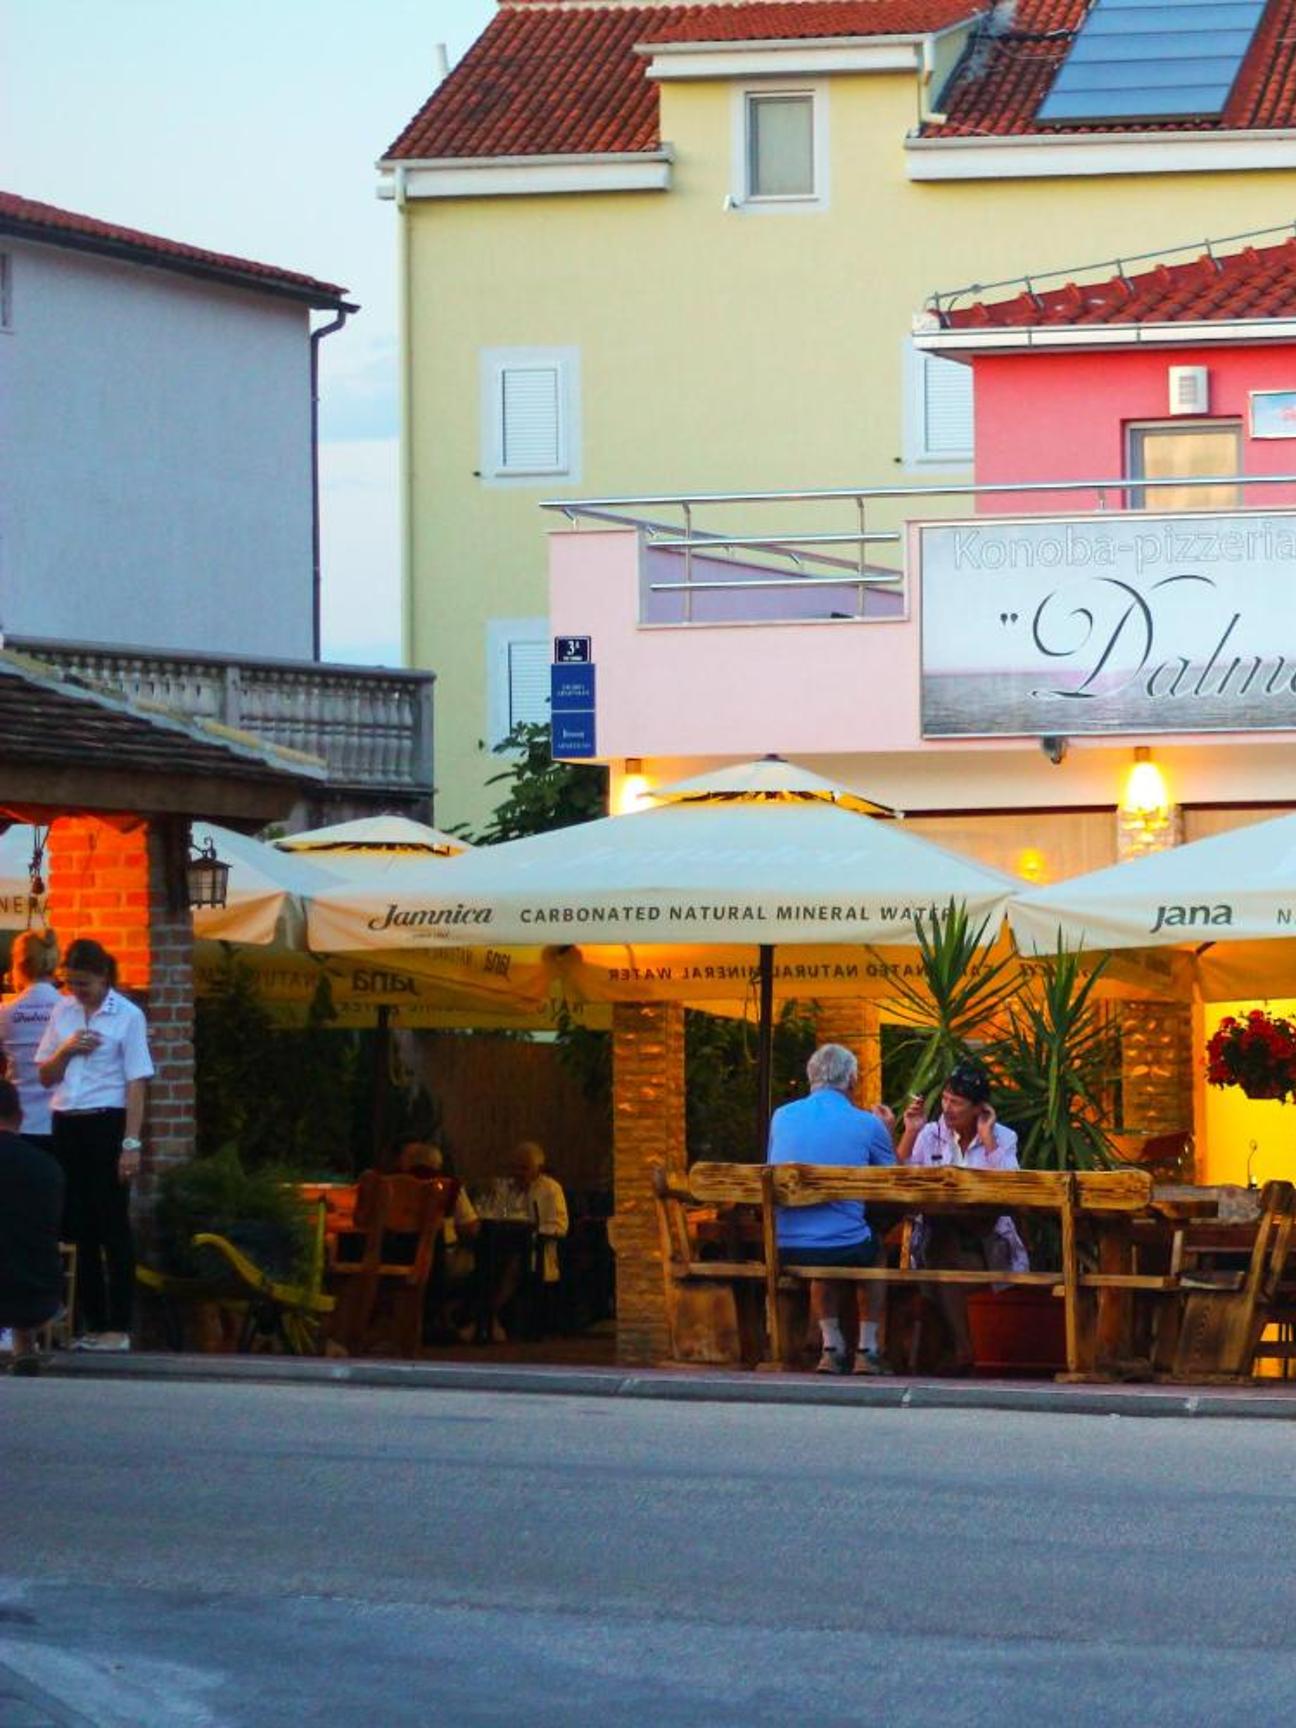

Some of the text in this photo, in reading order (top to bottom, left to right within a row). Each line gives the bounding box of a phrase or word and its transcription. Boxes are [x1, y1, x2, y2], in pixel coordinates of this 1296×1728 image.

[367, 903, 493, 931] Jamnica
[520, 906, 660, 923] CARBONATED
[669, 906, 766, 921] NATURAL
[776, 906, 870, 921] MINERAL
[1150, 903, 1233, 934] jana
